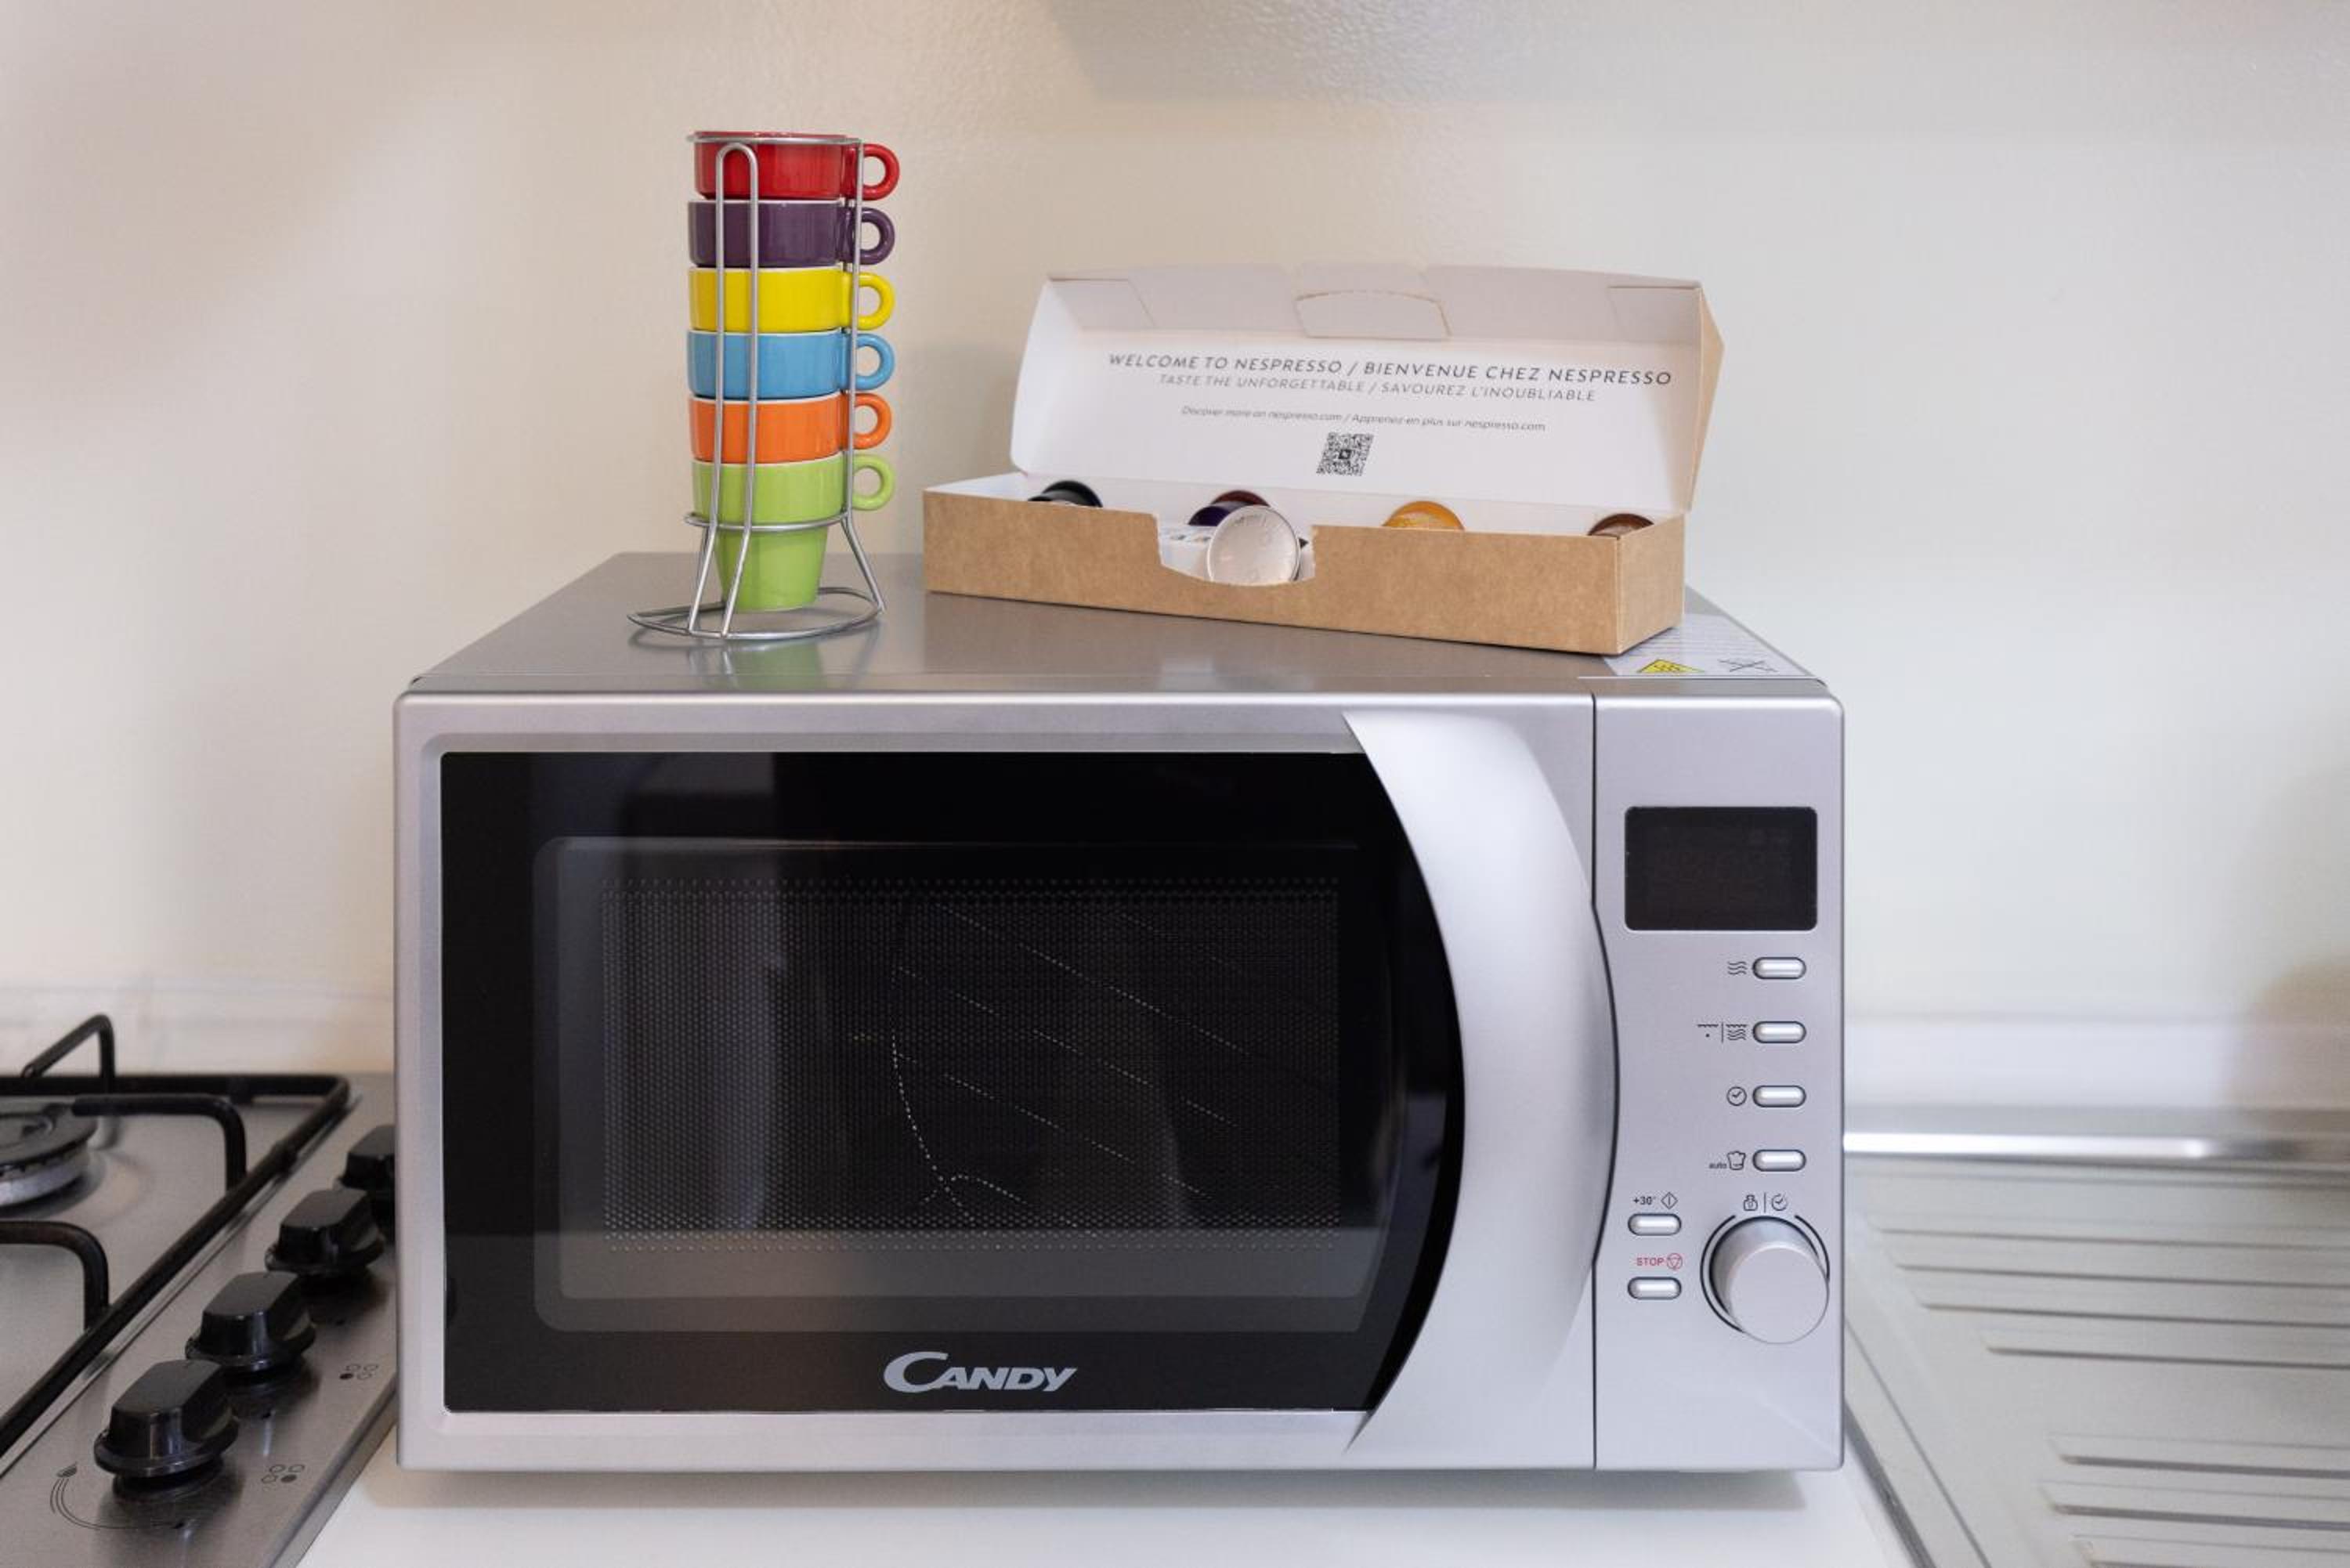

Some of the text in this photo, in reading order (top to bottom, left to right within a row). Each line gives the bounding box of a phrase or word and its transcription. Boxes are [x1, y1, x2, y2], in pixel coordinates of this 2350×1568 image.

[1109, 352, 1198, 370] WELCOME
[1204, 356, 1228, 370] TO
[1235, 357, 1343, 374] NESPRESSO
[1364, 361, 1479, 379] BIENVENUE
[1485, 365, 1539, 381] CHEZ
[1549, 368, 1672, 385] NESPRESSO
[1160, 374, 1202, 387] TASTE
[1206, 375, 1231, 388] THE
[1238, 377, 1364, 392] UNFORGETTABLE
[1381, 381, 1466, 397] SAVOUREZ
[1472, 385, 1596, 402] L'INOUBLIABLE
[1181, 405, 1224, 417] Discover
[1225, 409, 1251, 417] more
[1268, 410, 1342, 421] nespresso.com
[1422, 415, 1444, 428] plus
[1447, 418, 1461, 427] sur
[1464, 419, 1546, 432] nespresso.com
[1708, 1162, 1727, 1170] auto
[1636, 1256, 1665, 1266] STOP
[883, 1350, 1078, 1393] CANDY
